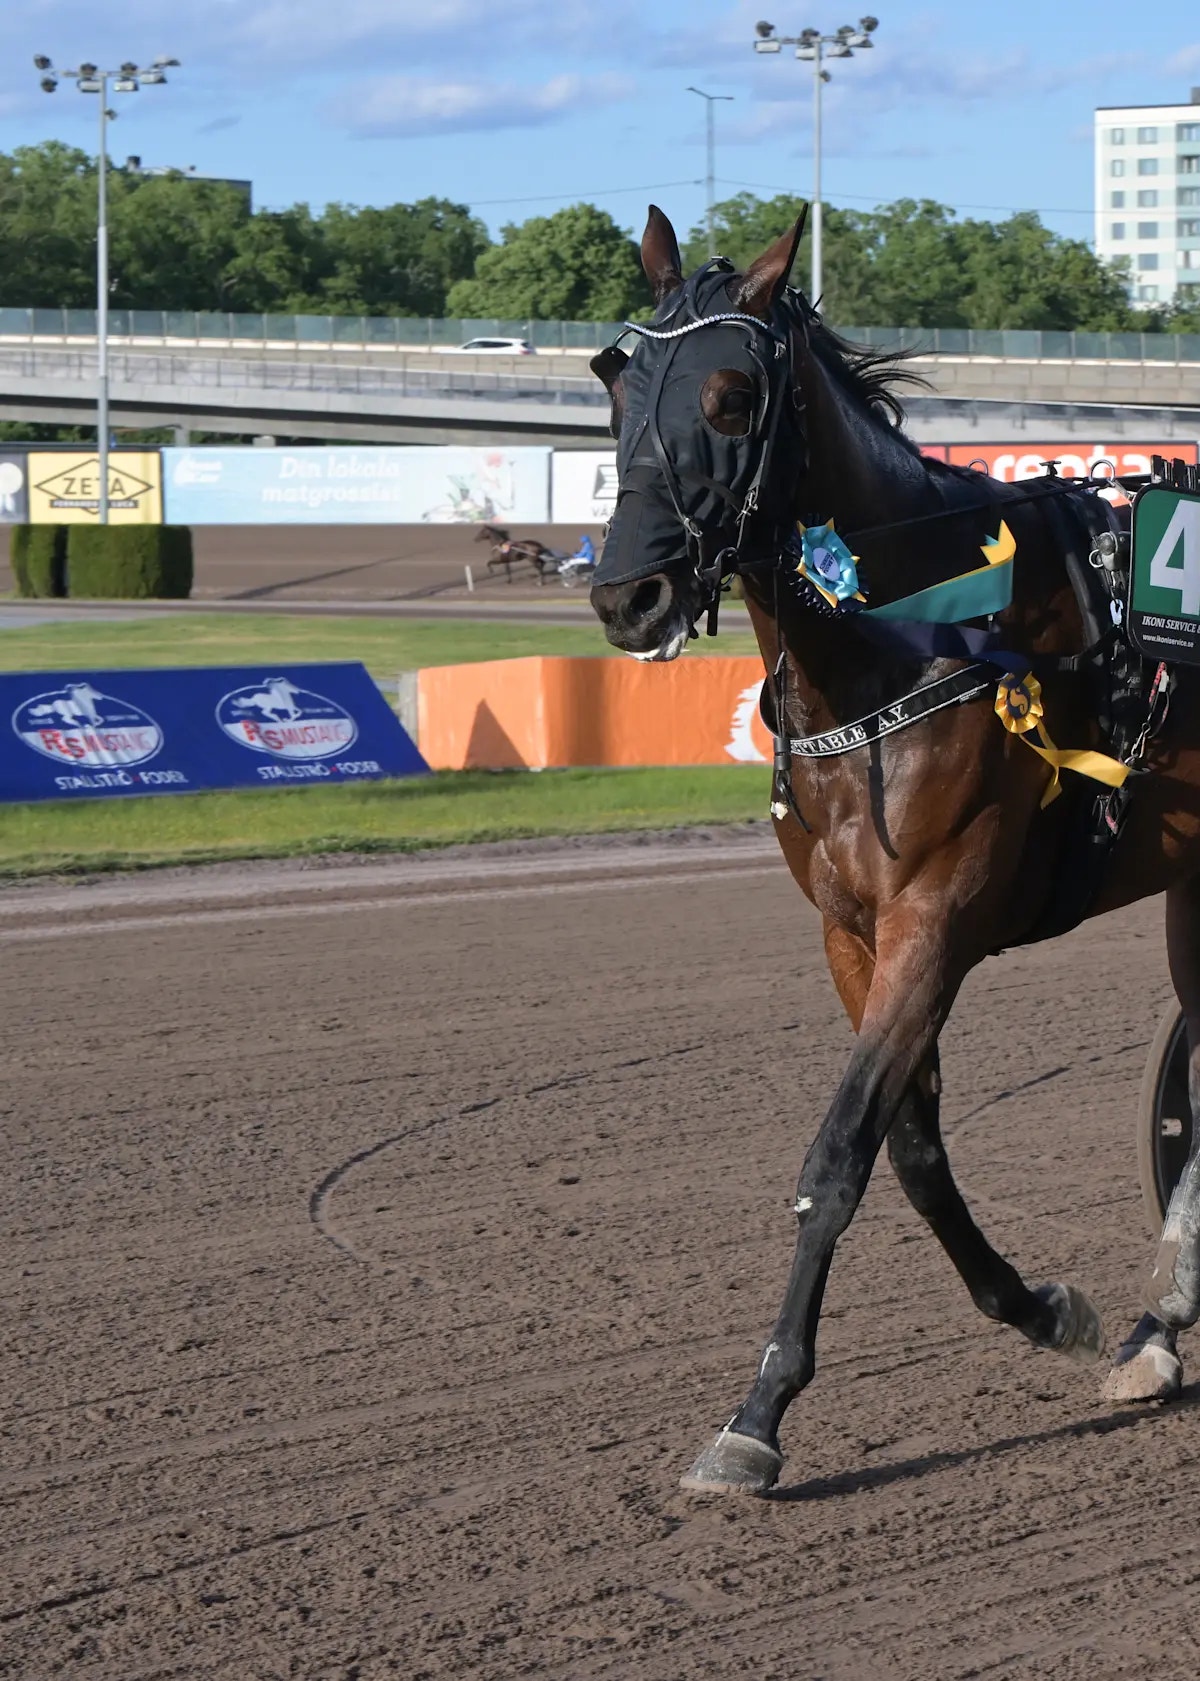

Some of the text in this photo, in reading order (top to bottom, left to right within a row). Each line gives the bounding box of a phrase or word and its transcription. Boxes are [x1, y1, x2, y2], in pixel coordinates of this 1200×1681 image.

[279, 456, 322, 478] Din
[1142, 615, 1166, 629] IKONI
[1165, 618, 1196, 634] SERVICE
[1142, 633, 1194, 648] www.ikoniservice.se
[878, 704, 909, 732] A.Y.
